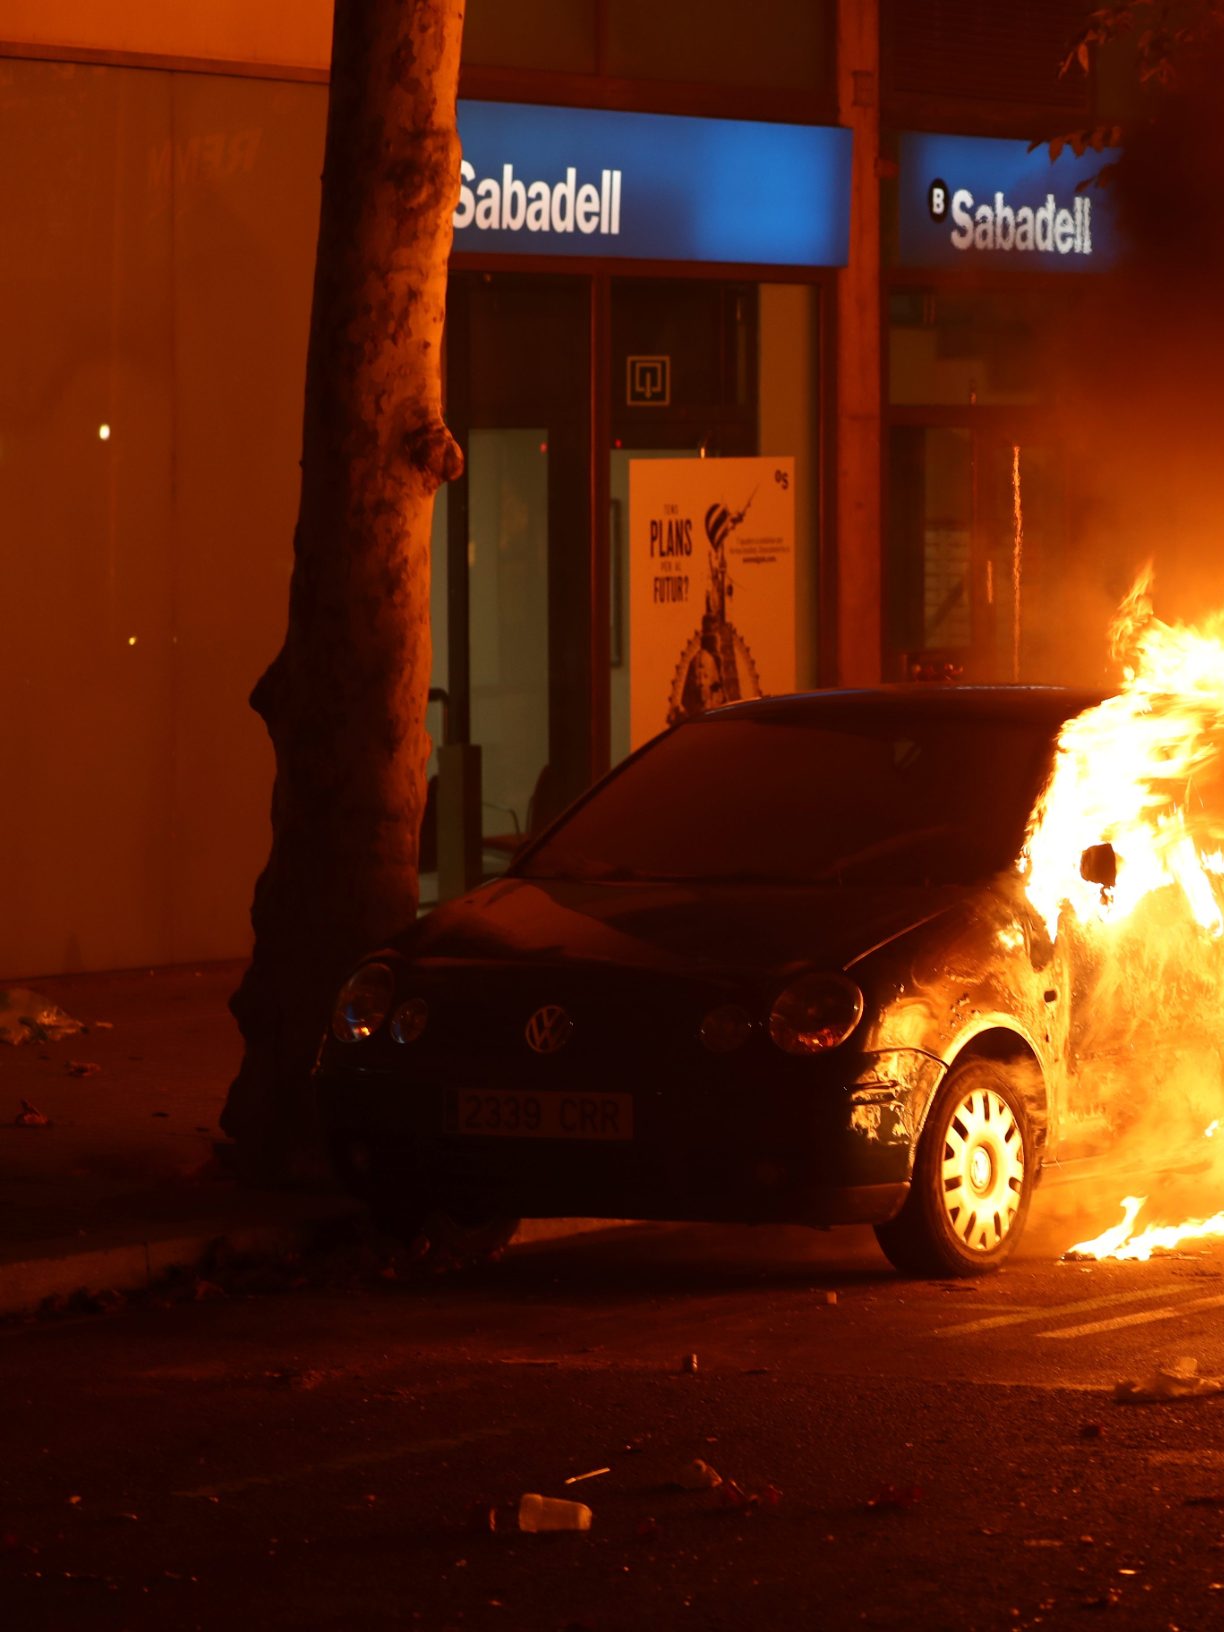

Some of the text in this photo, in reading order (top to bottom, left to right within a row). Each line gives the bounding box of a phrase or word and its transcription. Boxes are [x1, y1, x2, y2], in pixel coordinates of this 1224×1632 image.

[455, 158, 622, 235] Sabadell
[950, 188, 1093, 255] Sabadell
[649, 519, 692, 558] PLANS
[653, 576, 690, 603] FUTUR?
[465, 1094, 620, 1133] 2339 CRR
